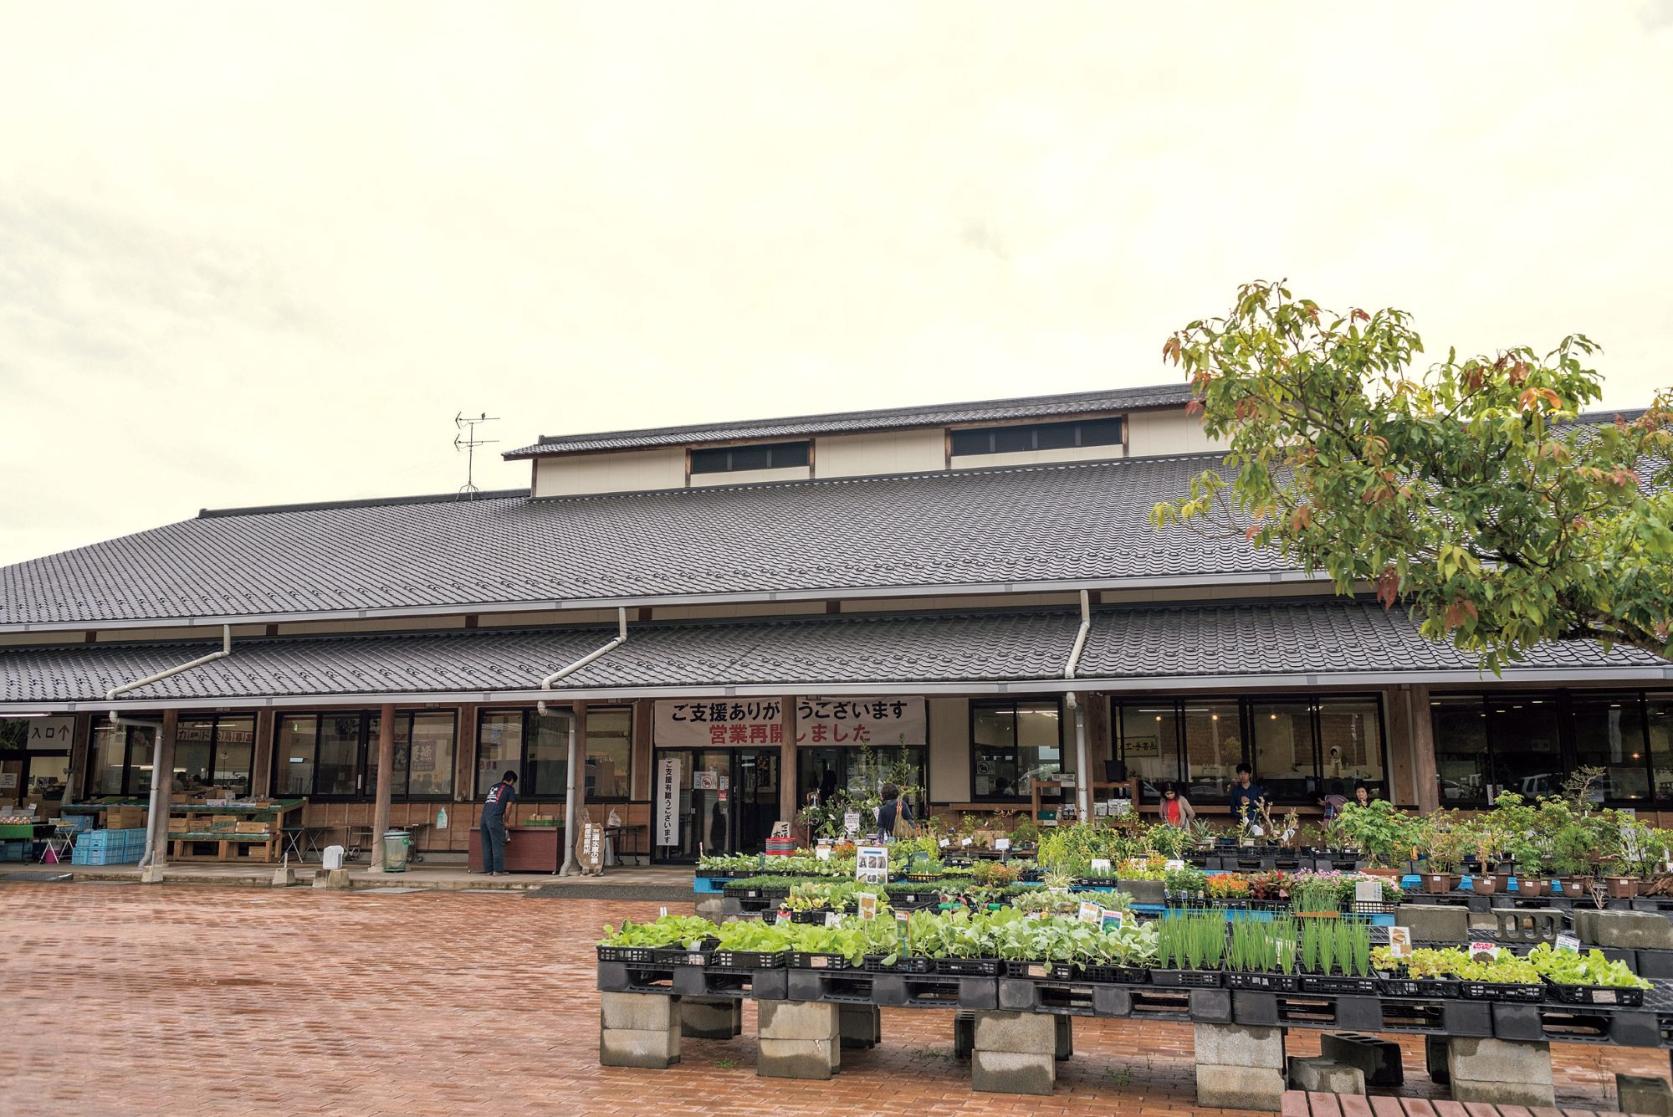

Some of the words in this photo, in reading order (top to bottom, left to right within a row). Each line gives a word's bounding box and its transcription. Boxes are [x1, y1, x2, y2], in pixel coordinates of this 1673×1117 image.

[672, 700, 908, 723] ご支援ありがうございます
[31, 727, 55, 739] 入口
